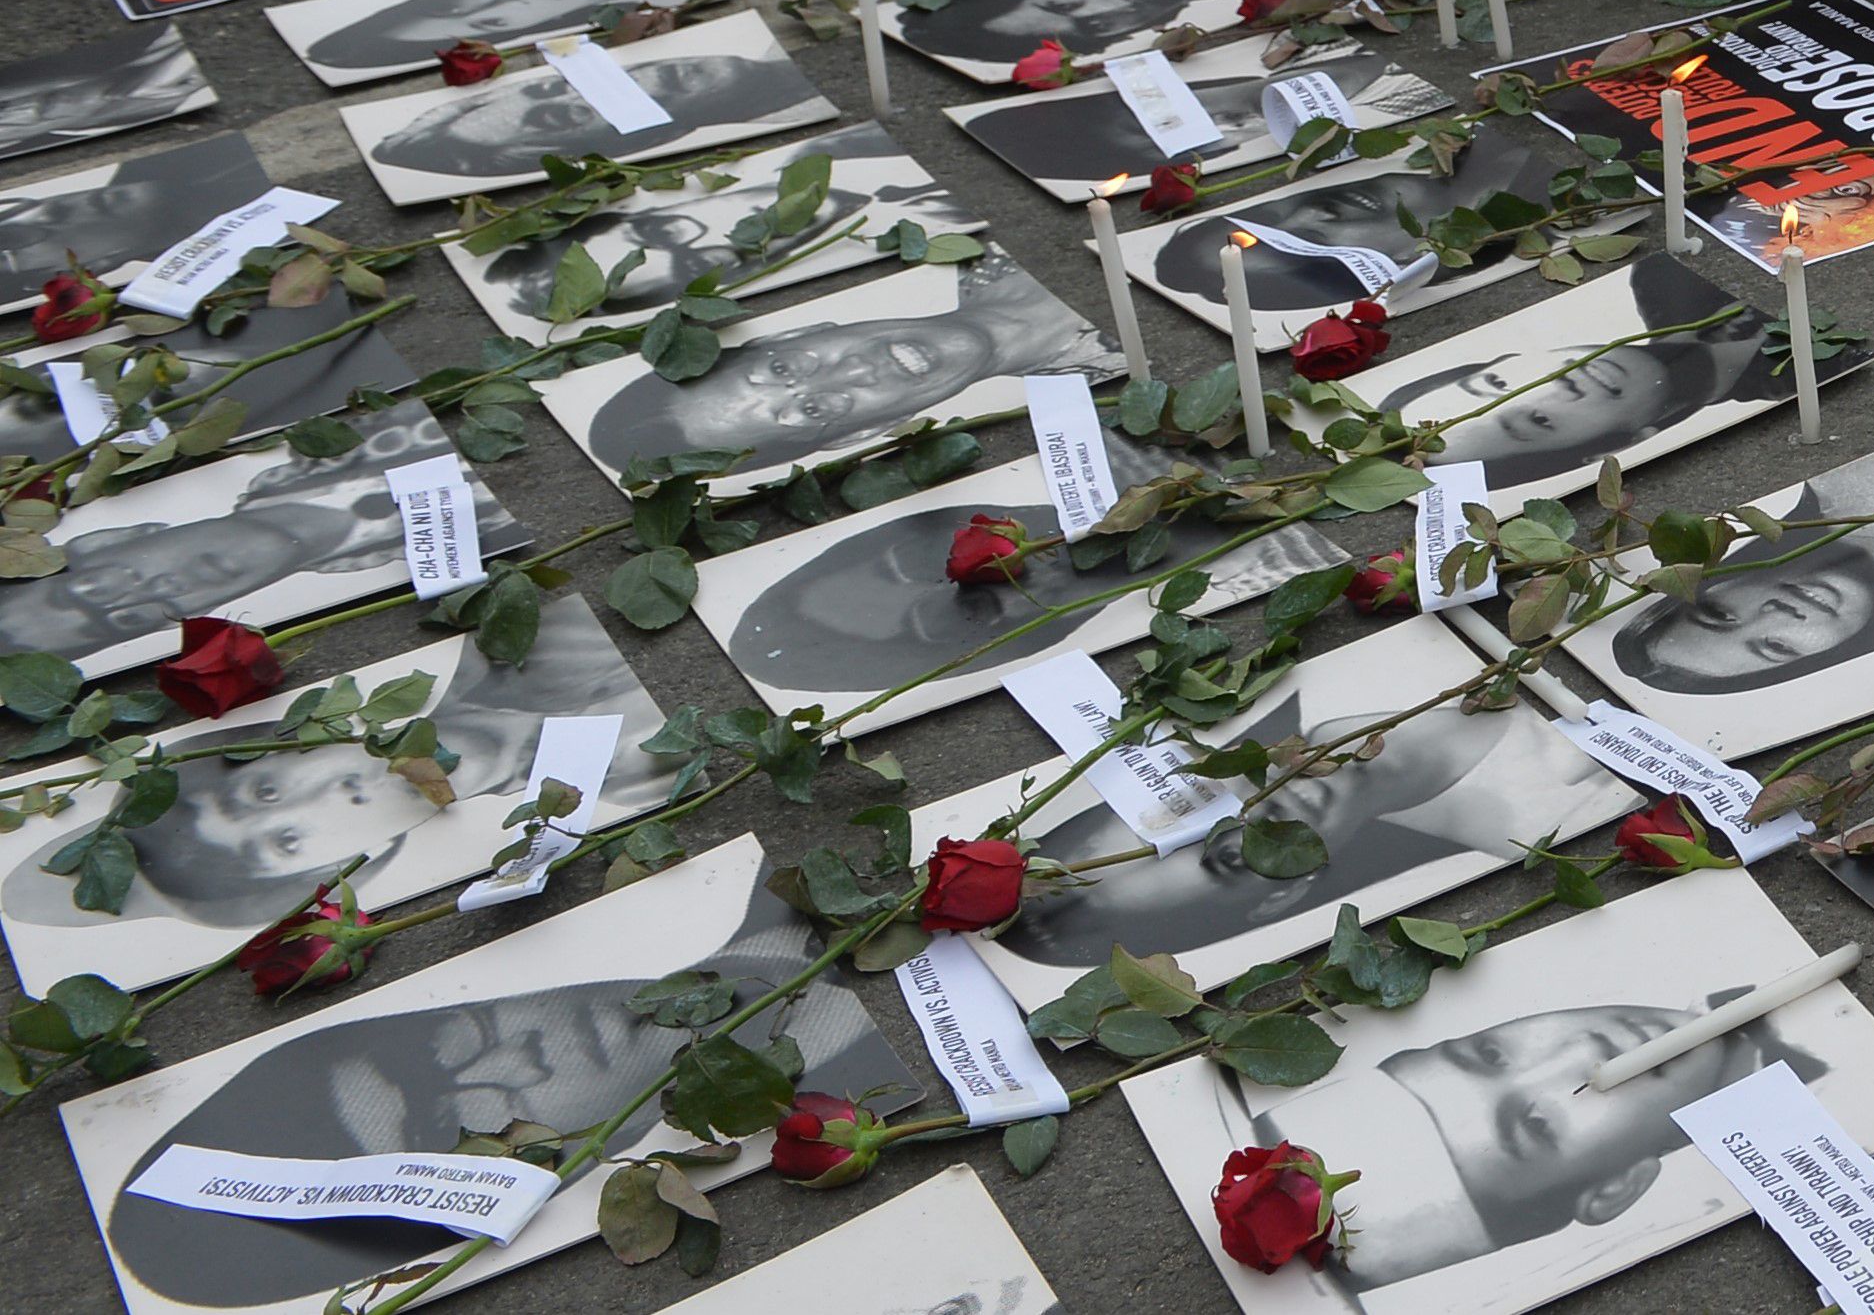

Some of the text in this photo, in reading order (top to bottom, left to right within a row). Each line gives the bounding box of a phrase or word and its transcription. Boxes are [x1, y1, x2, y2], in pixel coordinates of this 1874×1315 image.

[1805, 0, 1862, 28] MANILA
[1755, 19, 1833, 57] TYRANNY!
[1763, 42, 1809, 63] AND
[1046, 433, 1073, 478] IBASURA!
[411, 512, 432, 526] NI
[413, 528, 439, 579] CHA-CHA
[1072, 698, 1106, 725] LAW!
[1589, 730, 1645, 764] TOKHANG!
[1627, 726, 1655, 744] MANILA
[1649, 739, 1676, 756] METRO
[1122, 750, 1147, 769] TO
[1637, 754, 1667, 776] END
[1698, 766, 1717, 780] FOR
[1134, 762, 1171, 795] AGAIN
[1723, 776, 1743, 794] LIFE
[1703, 787, 1734, 817] THE
[924, 995, 951, 1017] VS.
[930, 1013, 981, 1074] CRACKDOWN
[1720, 1130, 1783, 1187] DUTERTE'S
[1812, 1134, 1843, 1159] MANILA
[396, 1164, 517, 1189] BAYAN METRO MANILA
[1779, 1144, 1842, 1199] TYRANNY!
[1834, 1157, 1864, 1180] METRO
[199, 1177, 500, 1217] RESIST CRACKDOWN VS. ACTIVISTS!
[1765, 1182, 1825, 1230] AGAINST
[1824, 1191, 1864, 1220] AND
[1807, 1226, 1860, 1272] POWER
